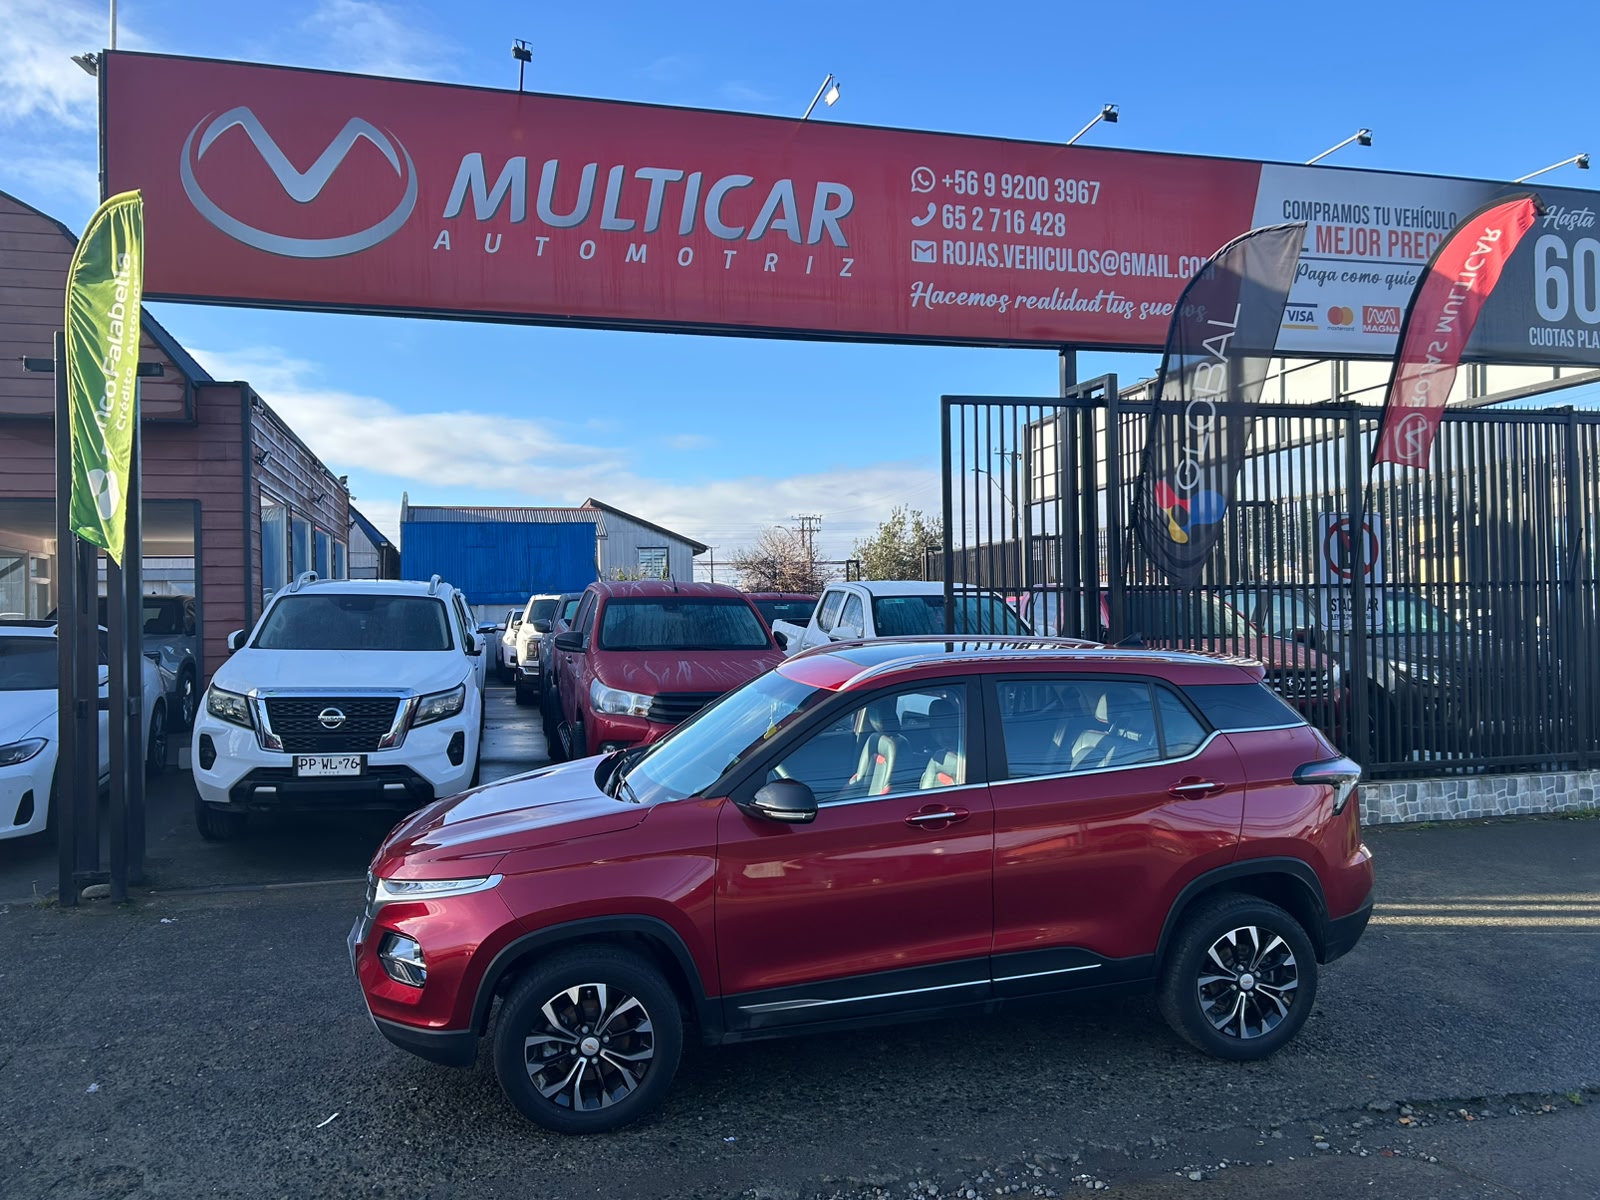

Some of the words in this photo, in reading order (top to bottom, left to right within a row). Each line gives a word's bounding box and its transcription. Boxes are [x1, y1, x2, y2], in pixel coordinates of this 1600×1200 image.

[443, 152, 855, 248] MULTICAR
[942, 169, 978, 196] +56
[983, 172, 996, 198] 9
[1001, 174, 1048, 202] 9200
[1054, 177, 1101, 205] 3967
[942, 204, 966, 232] 65
[971, 206, 984, 232] 2
[989, 208, 1025, 235] 716
[1030, 211, 1066, 237] 428
[1283, 199, 1370, 226] COMPRAMOS
[1373, 206, 1390, 227] TU
[1394, 205, 1457, 231] VEHÍCULO
[1543, 205, 1596, 231] Hasta
[433, 229, 854, 277] AUTOMOTRIZ
[1315, 224, 1382, 257] MEJOR
[1294, 263, 1338, 287] Paga
[1341, 270, 1382, 283] como
[1385, 270, 1417, 290] quie
[1534, 234, 1600, 325] 60
[910, 281, 1012, 313] Hacemos
[1014, 288, 1102, 313] realidad
[1103, 290, 1136, 319] tus
[1286, 310, 1314, 322] VISA
[1363, 325, 1400, 333] MAGNA
[1529, 327, 1575, 347] CUOTAS
[1578, 330, 1600, 349] PLA
[116, 367, 133, 430] Crédito
[1176, 303, 1241, 490] GLOBAL
